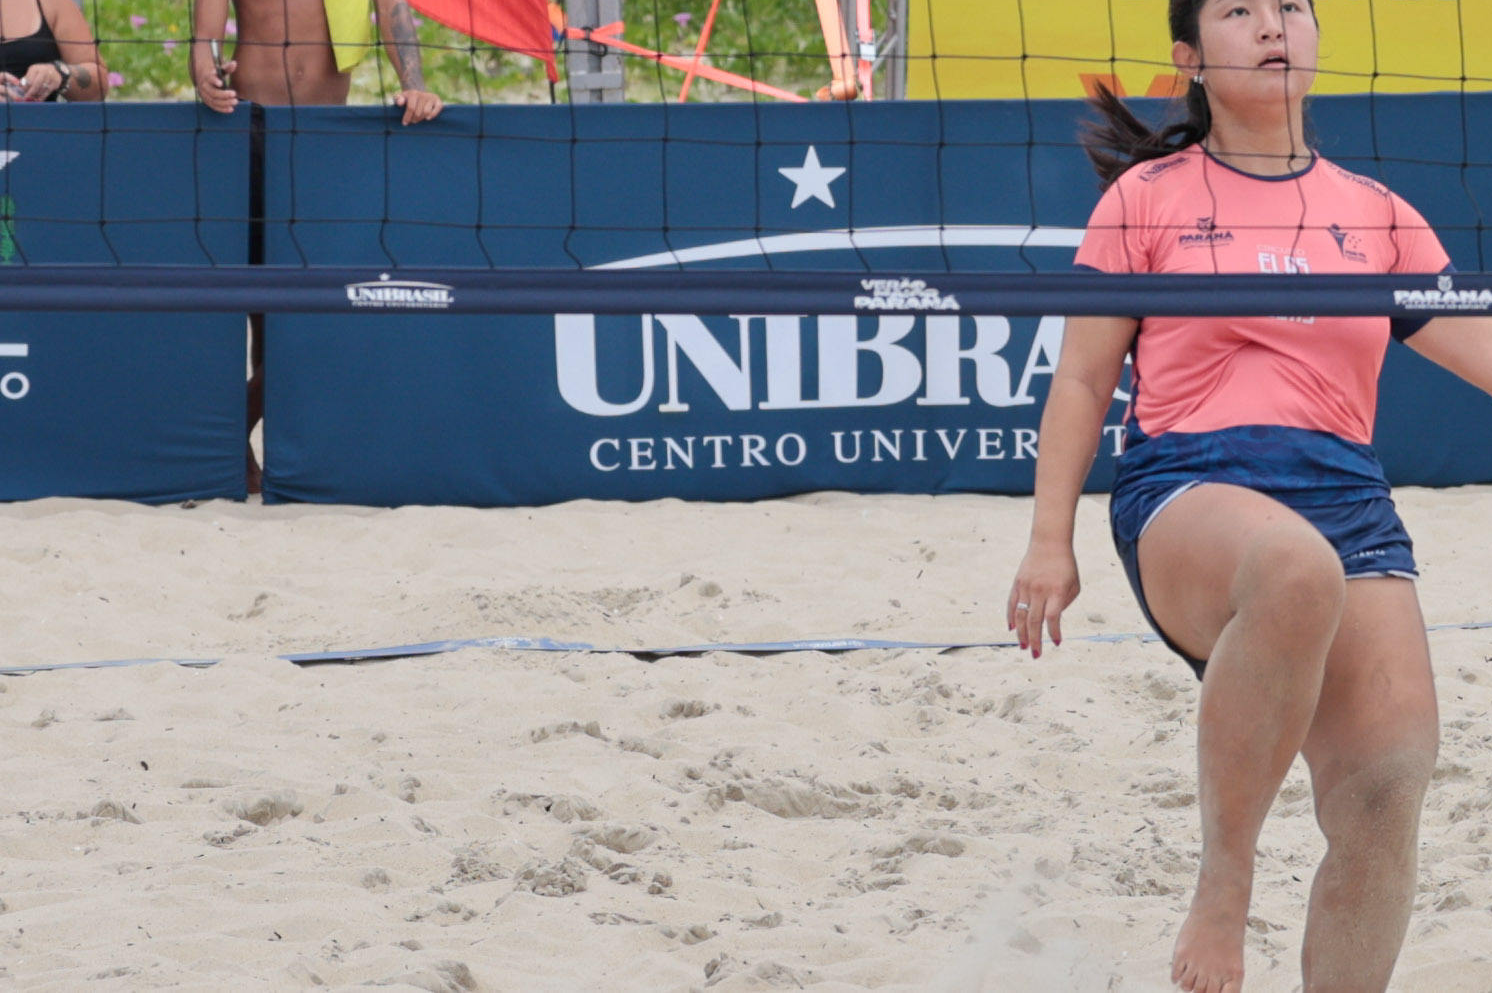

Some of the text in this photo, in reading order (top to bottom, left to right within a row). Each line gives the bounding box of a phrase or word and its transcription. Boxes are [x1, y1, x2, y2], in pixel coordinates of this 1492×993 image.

[554, 314, 1131, 416] UNIBRA
[589, 425, 1128, 471] CENTRO UNIVERT
